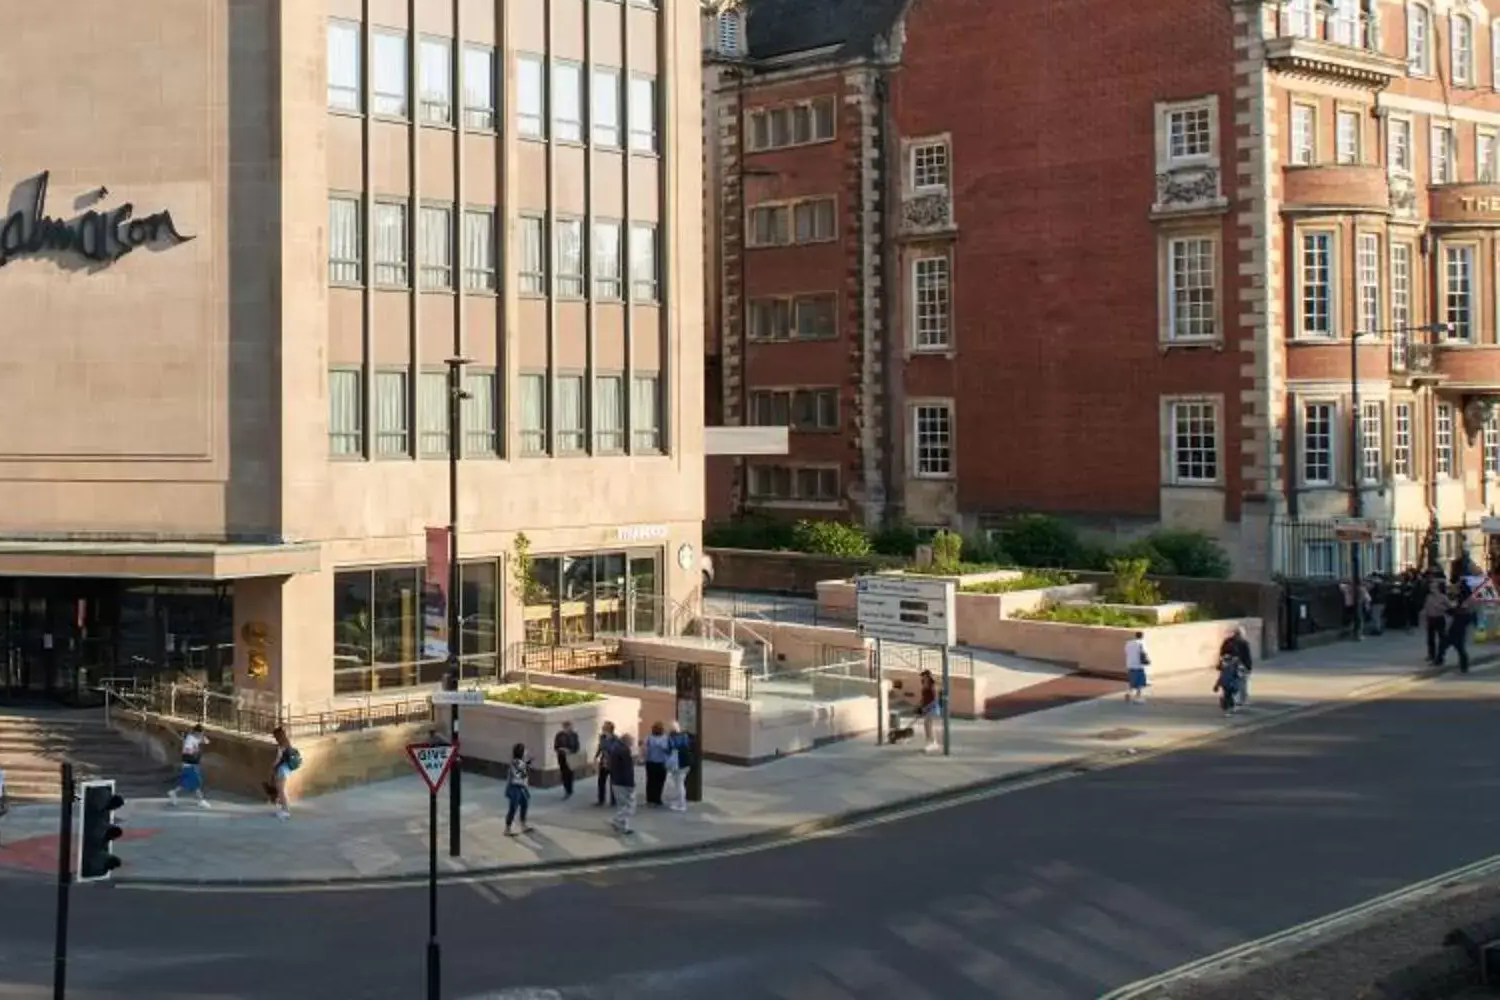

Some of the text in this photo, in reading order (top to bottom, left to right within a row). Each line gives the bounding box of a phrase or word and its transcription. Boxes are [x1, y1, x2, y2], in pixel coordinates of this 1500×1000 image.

[1461, 196, 1500, 211] THE
[418, 749, 448, 760] GIVE
[426, 762, 443, 770] WAY
